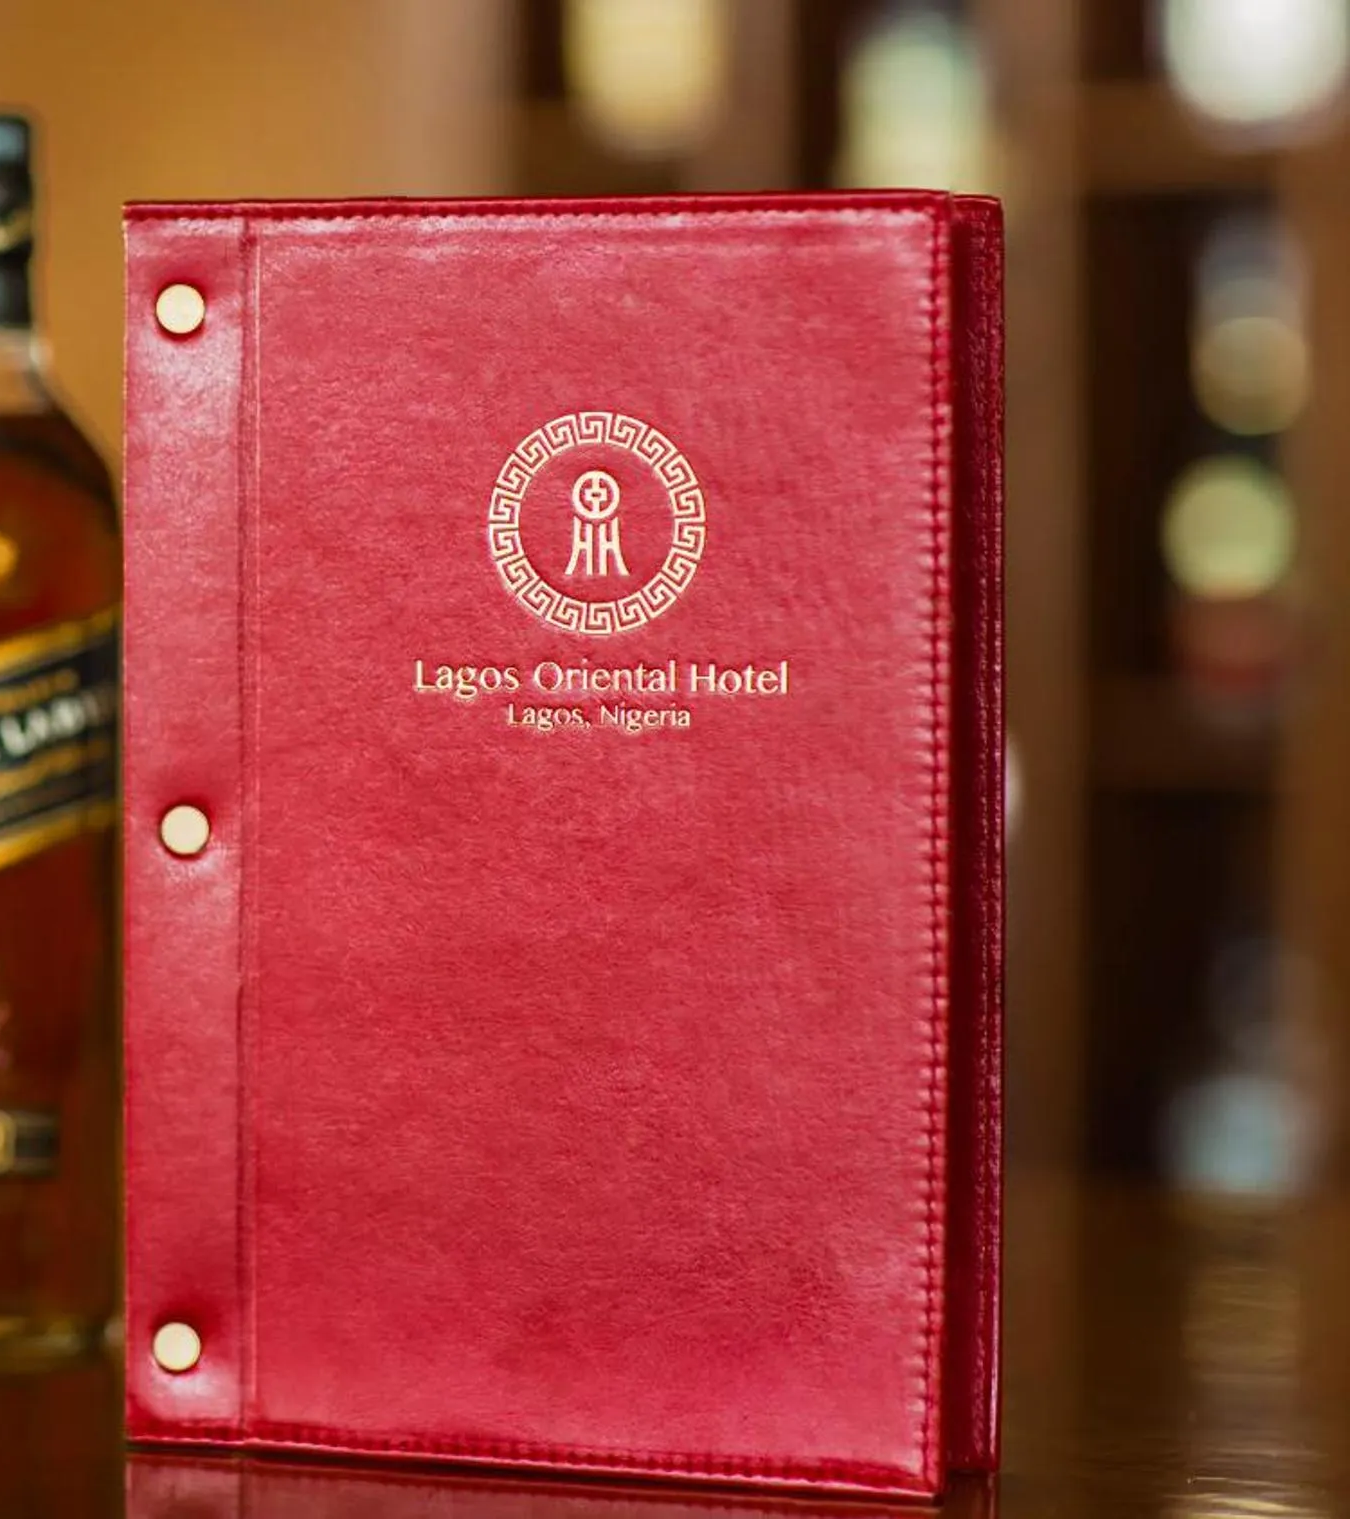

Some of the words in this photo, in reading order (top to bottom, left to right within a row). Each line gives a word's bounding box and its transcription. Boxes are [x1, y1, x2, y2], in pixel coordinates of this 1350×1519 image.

[413, 659, 520, 698] Lagos
[533, 658, 677, 692] Oriental
[690, 660, 789, 695] Hotel
[507, 703, 591, 732] Lagos,
[600, 704, 691, 731] Nigeria
